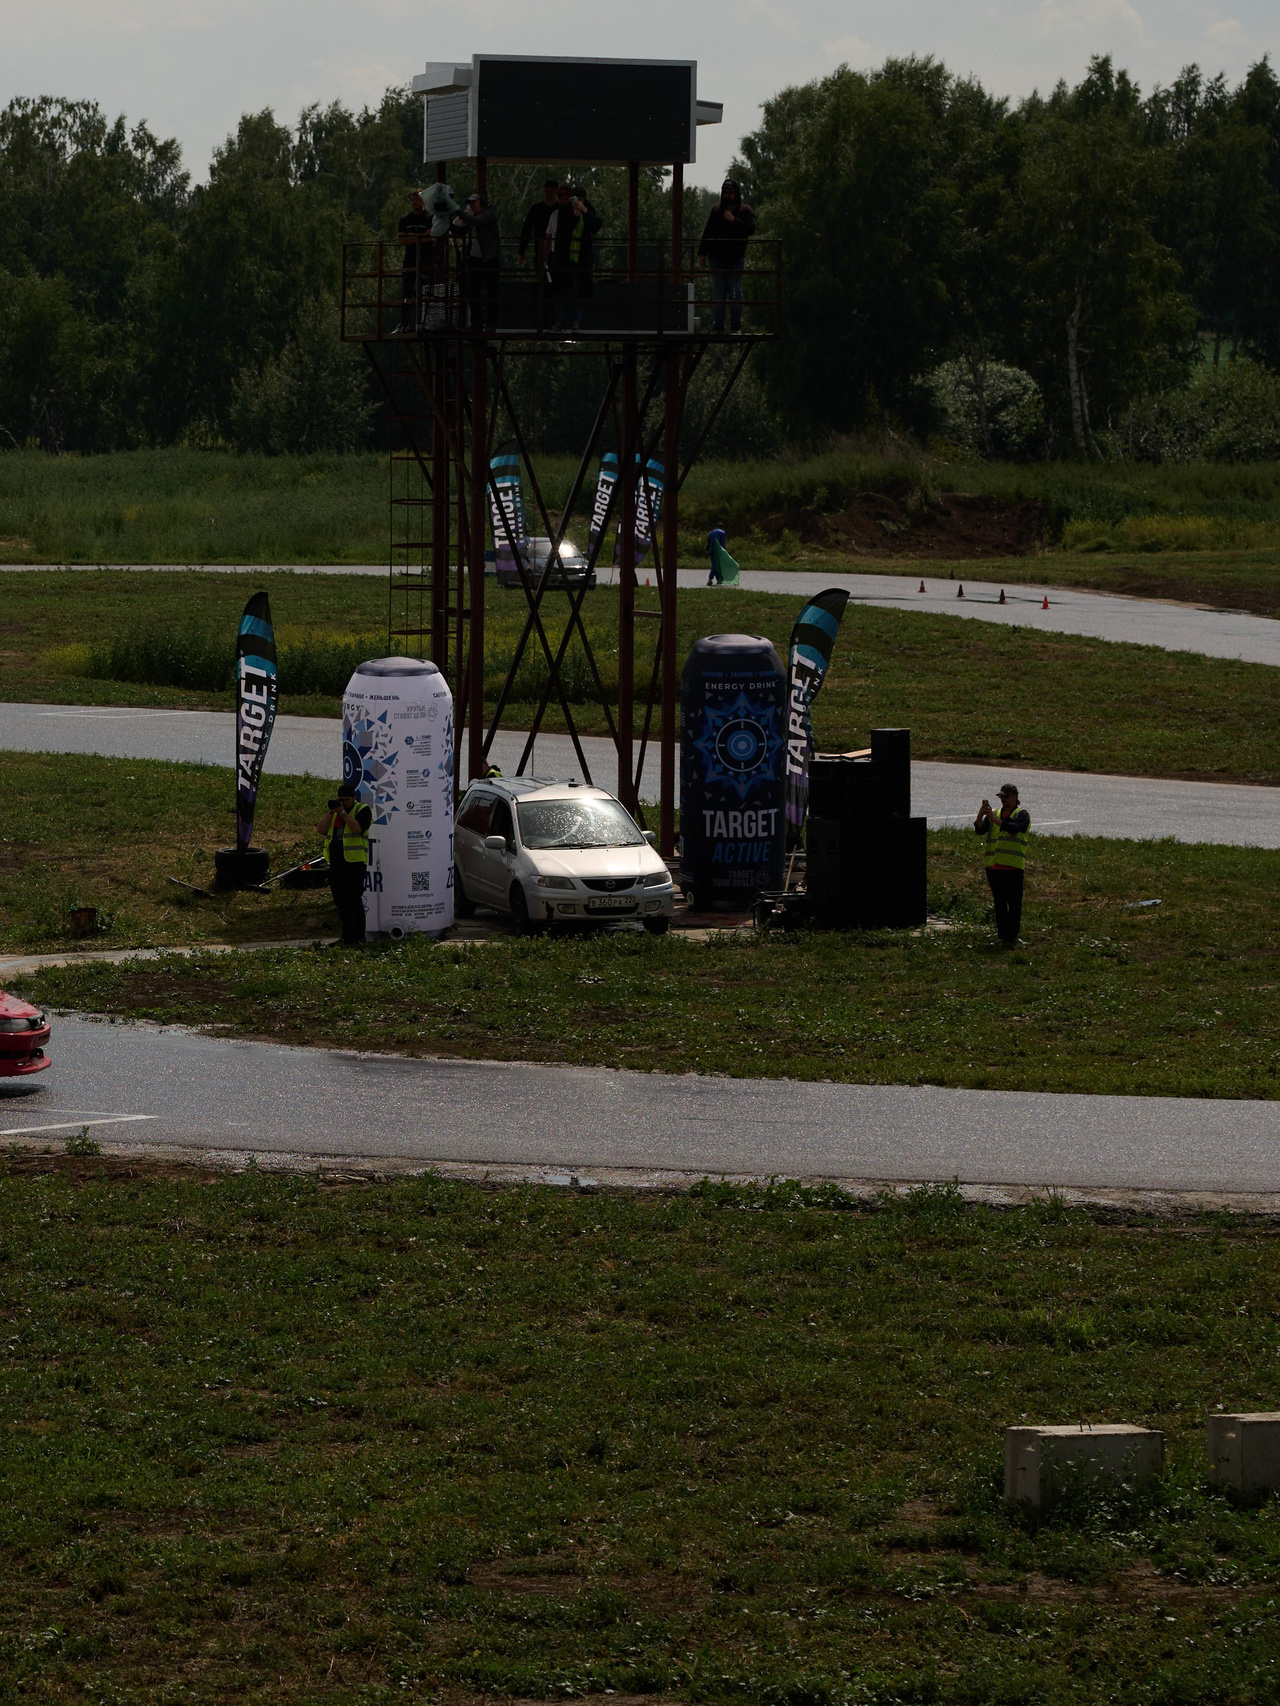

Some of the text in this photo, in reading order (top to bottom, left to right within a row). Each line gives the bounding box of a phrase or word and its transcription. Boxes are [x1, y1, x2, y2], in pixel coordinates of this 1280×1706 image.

[590, 471, 616, 533] TARGET
[269, 673, 277, 723] DRINK
[749, 682, 776, 690] DRINK
[238, 656, 268, 791] TARGET
[702, 808, 778, 838] TARGET
[712, 841, 772, 863] ACTIVE
[712, 878, 754, 887] YOUR GOALS
[728, 870, 754, 878] TARGET
